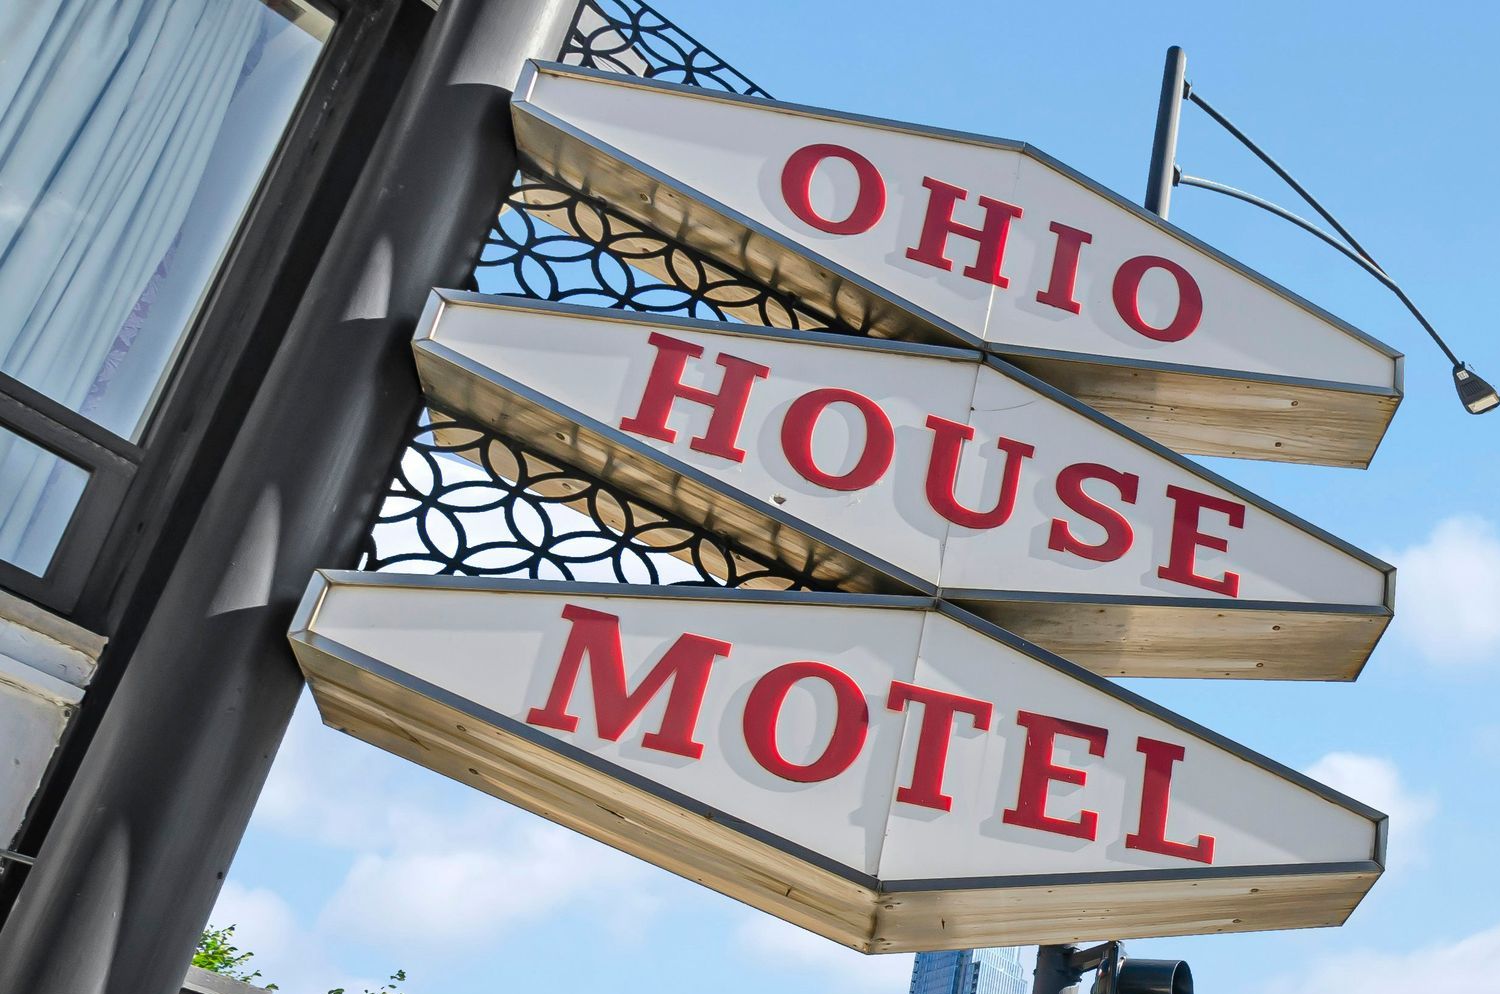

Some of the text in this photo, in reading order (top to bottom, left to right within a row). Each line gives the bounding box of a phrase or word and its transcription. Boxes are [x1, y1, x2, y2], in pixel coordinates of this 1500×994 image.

[780, 143, 1204, 343] OHIO
[618, 331, 1246, 599] HOUSE
[526, 603, 1216, 866] MOTEL
